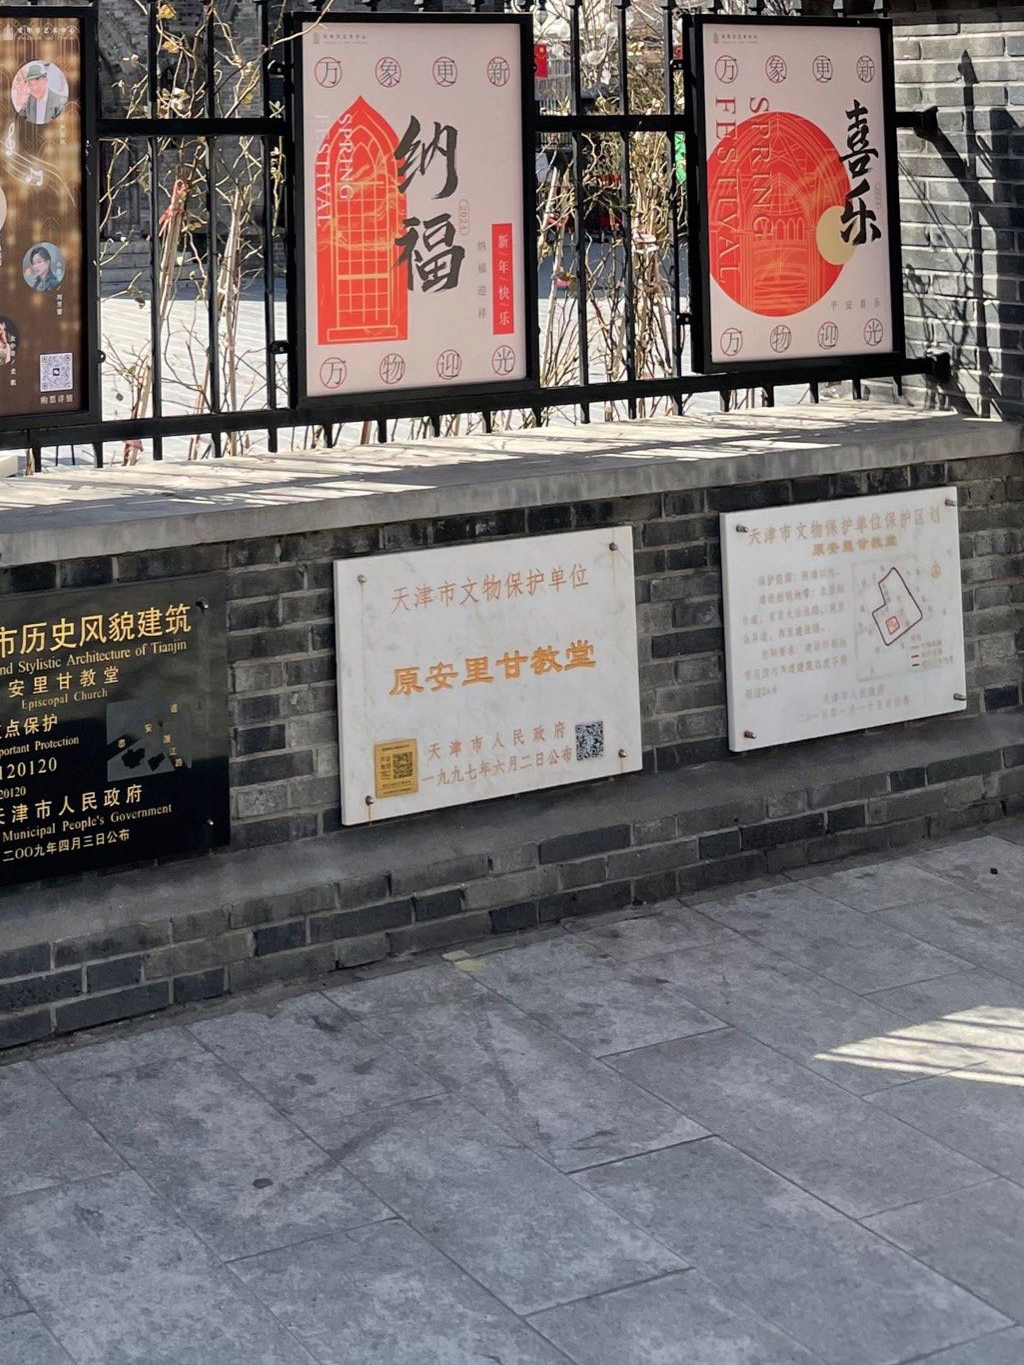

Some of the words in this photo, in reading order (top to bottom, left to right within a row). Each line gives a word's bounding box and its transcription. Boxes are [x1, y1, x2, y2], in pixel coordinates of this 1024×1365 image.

[315, 56, 511, 87] 万象更新
[715, 55, 875, 83] 万象更新
[314, 114, 333, 228] FESTIVAL
[337, 113, 355, 200] SPRING
[748, 96, 774, 240] SPRING
[838, 99, 882, 246] 喜乐
[390, 114, 466, 293] 纳福
[714, 97, 740, 285] FESTIVAL
[720, 318, 884, 356] 万物迎光
[320, 345, 516, 389] 万物迎光
[391, 564, 589, 615] 天津市文物保护单位
[17, 655, 62, 675] Stylistic
[66, 648, 131, 667] Architecture
[135, 643, 147, 657] of
[150, 638, 188, 656] Tianjin
[388, 640, 597, 696] 原安里甘教堂
[8, 666, 120, 699] 安里甘教堂
[21, 692, 69, 711] Episcopal
[73, 688, 109, 703] Church
[34, 735, 80, 752] Protection
[427, 721, 567, 762] 天津市人民政府
[1, 824, 57, 843] Municipal
[61, 814, 105, 835] People's
[109, 803, 173, 824] Government
